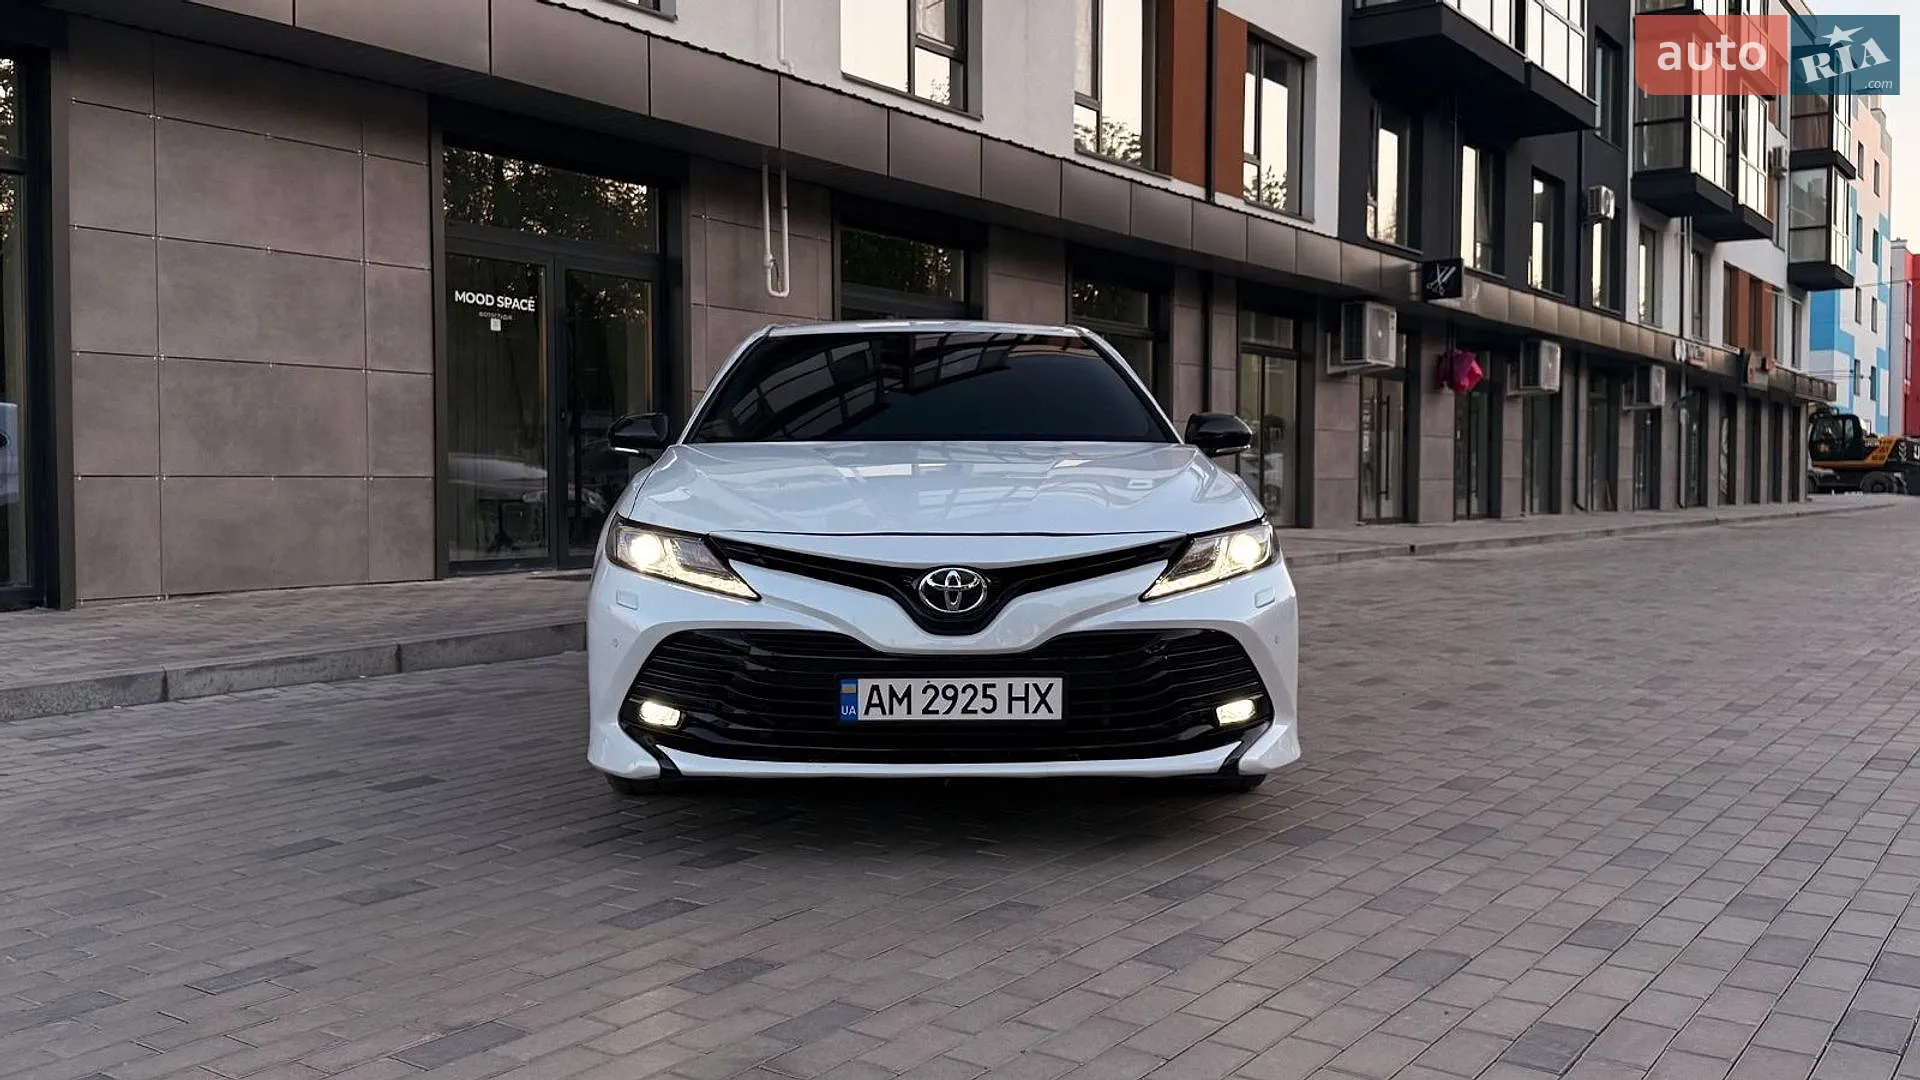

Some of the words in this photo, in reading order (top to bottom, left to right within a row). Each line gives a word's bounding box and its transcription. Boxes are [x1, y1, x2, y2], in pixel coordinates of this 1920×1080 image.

[454, 290, 495, 306] MOOD
[496, 295, 536, 312] SPACE
[863, 684, 913, 715] AM
[921, 683, 998, 715] 2925
[1007, 683, 1054, 714] HX
[841, 706, 857, 715] UA
